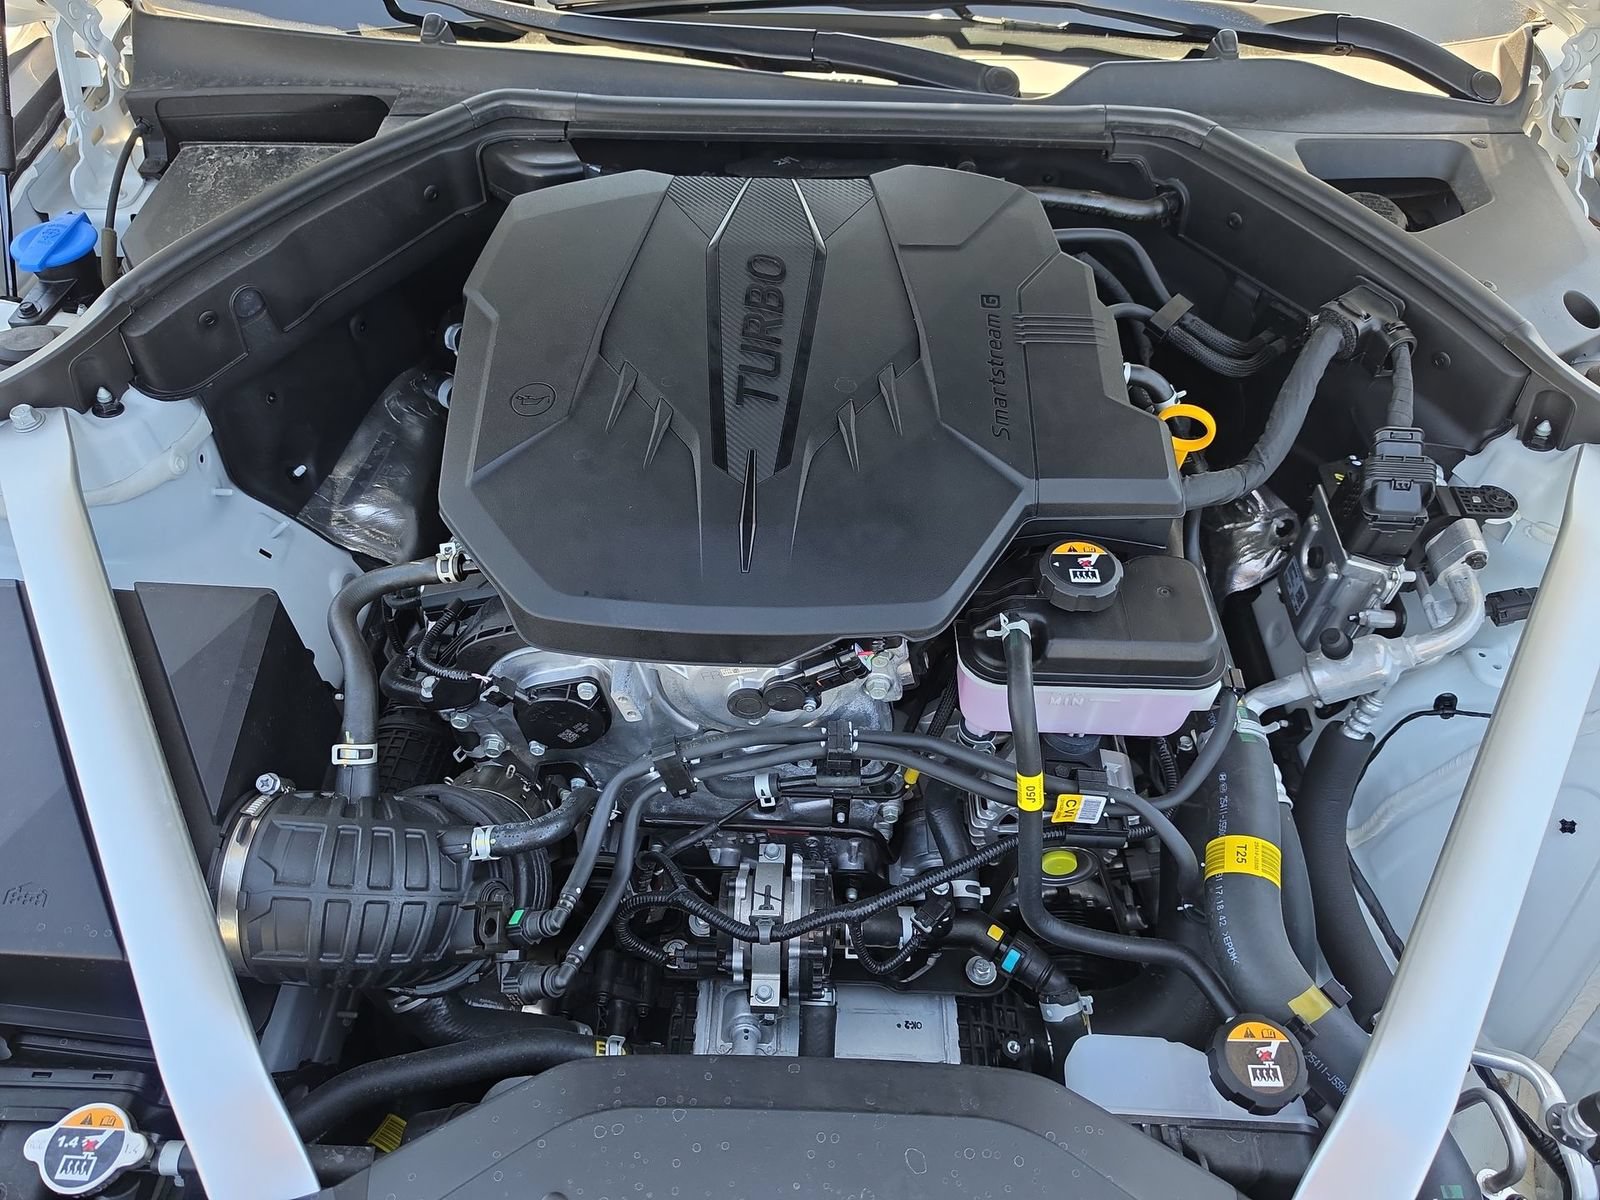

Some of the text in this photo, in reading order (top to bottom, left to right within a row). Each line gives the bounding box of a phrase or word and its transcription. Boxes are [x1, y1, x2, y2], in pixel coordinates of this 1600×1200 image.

[736, 254, 787, 405] TURBO
[987, 313, 1011, 441] Smartstream
[1048, 696, 1085, 706] MIN
[1025, 785, 1036, 803] J50
[1236, 844, 1248, 865] T25
[904, 1020, 923, 1030] OK-2
[57, 1135, 79, 1148] 1.4
